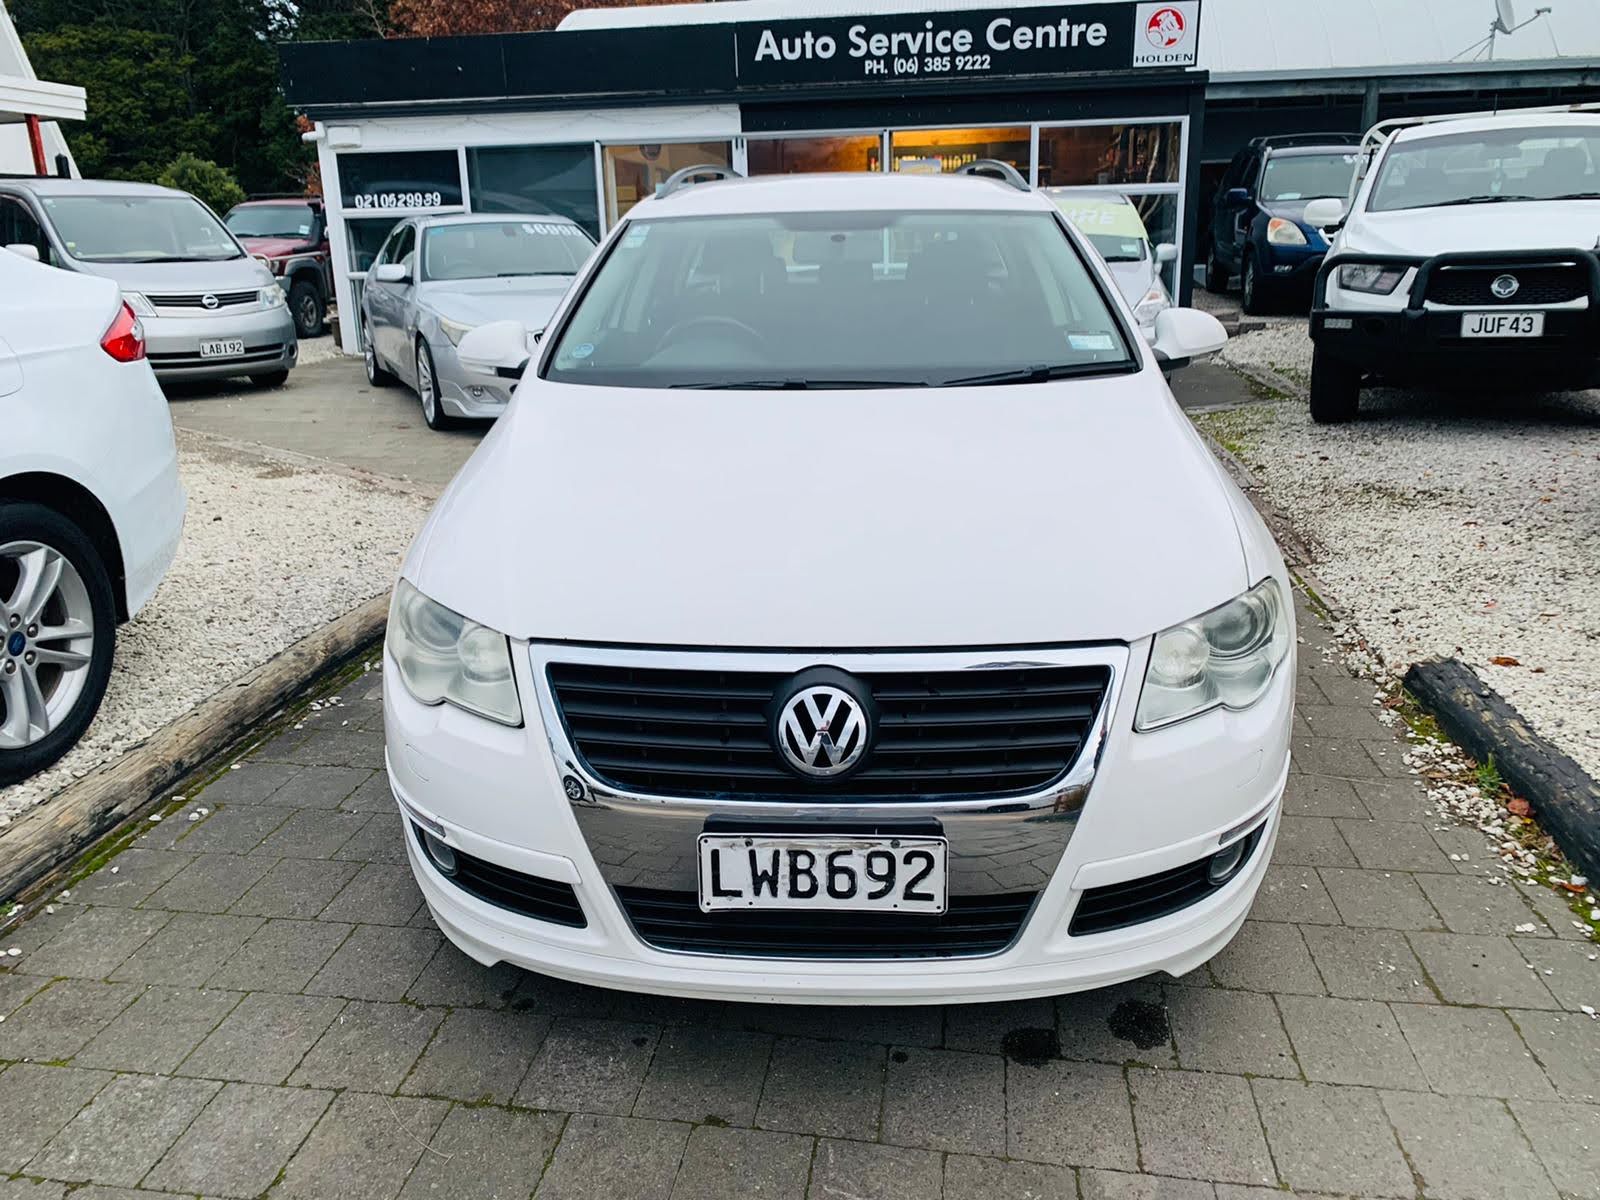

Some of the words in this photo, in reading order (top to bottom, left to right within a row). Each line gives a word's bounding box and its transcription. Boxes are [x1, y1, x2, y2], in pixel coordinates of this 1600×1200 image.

[754, 29, 837, 62] Auto
[848, 19, 973, 58] Service
[985, 17, 1108, 51] Centre
[864, 59, 889, 75] PH.
[893, 56, 919, 75] (06)
[923, 56, 950, 72] 385
[955, 54, 991, 71] 9222
[1135, 53, 1193, 64] HOLDEN
[1471, 316, 1534, 334] JUF43
[201, 342, 243, 355] LAB192
[710, 848, 936, 901] LWB692
